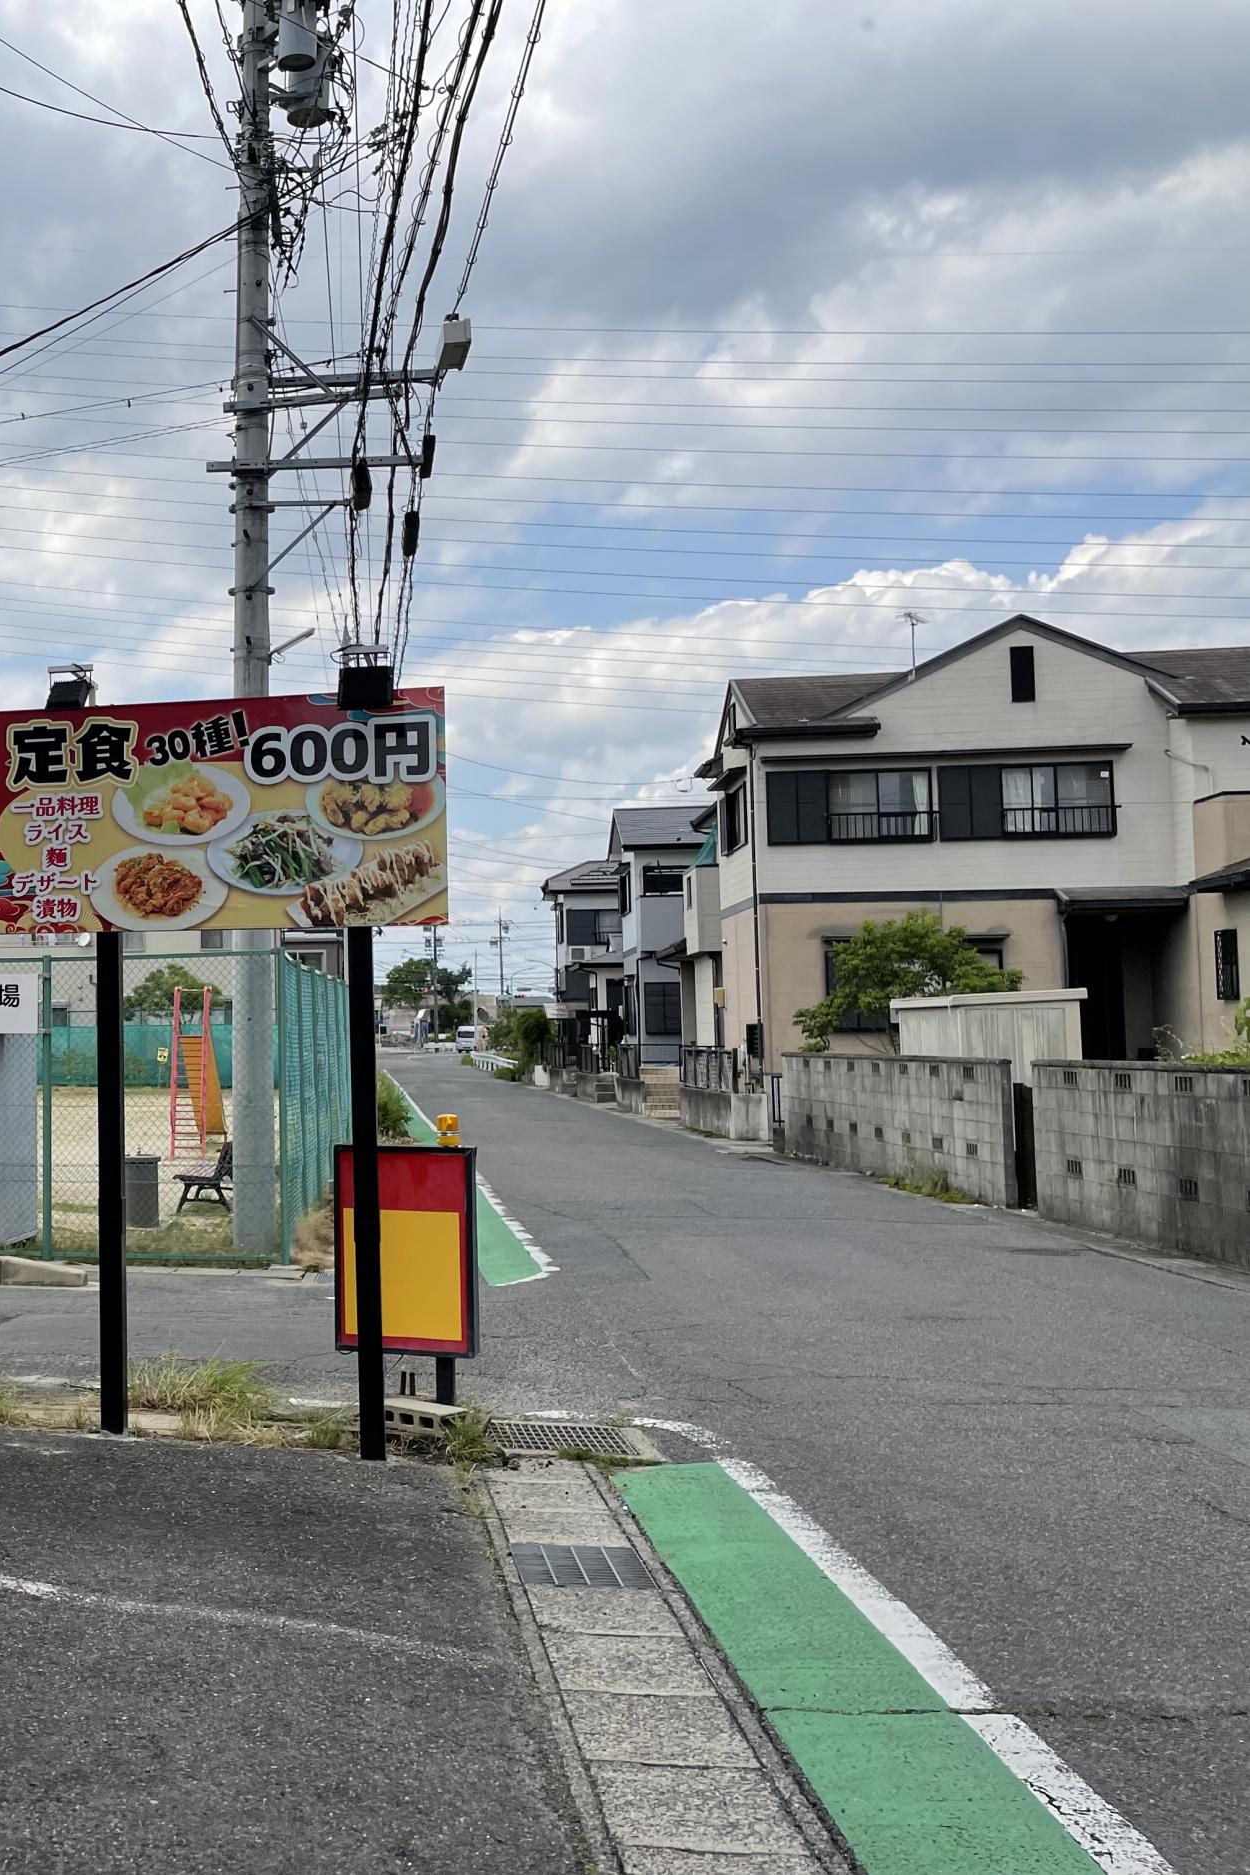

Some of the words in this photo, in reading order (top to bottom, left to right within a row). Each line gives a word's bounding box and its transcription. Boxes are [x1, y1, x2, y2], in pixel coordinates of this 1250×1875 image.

[11, 723, 134, 784] 定食
[146, 711, 250, 767] 30種!
[250, 722, 432, 779] 600円
[13, 796, 100, 817] 一品料理
[27, 823, 88, 841] ライス
[45, 847, 68, 868] 麺
[15, 872, 97, 894] デザート
[36, 898, 78, 919] 漬物
